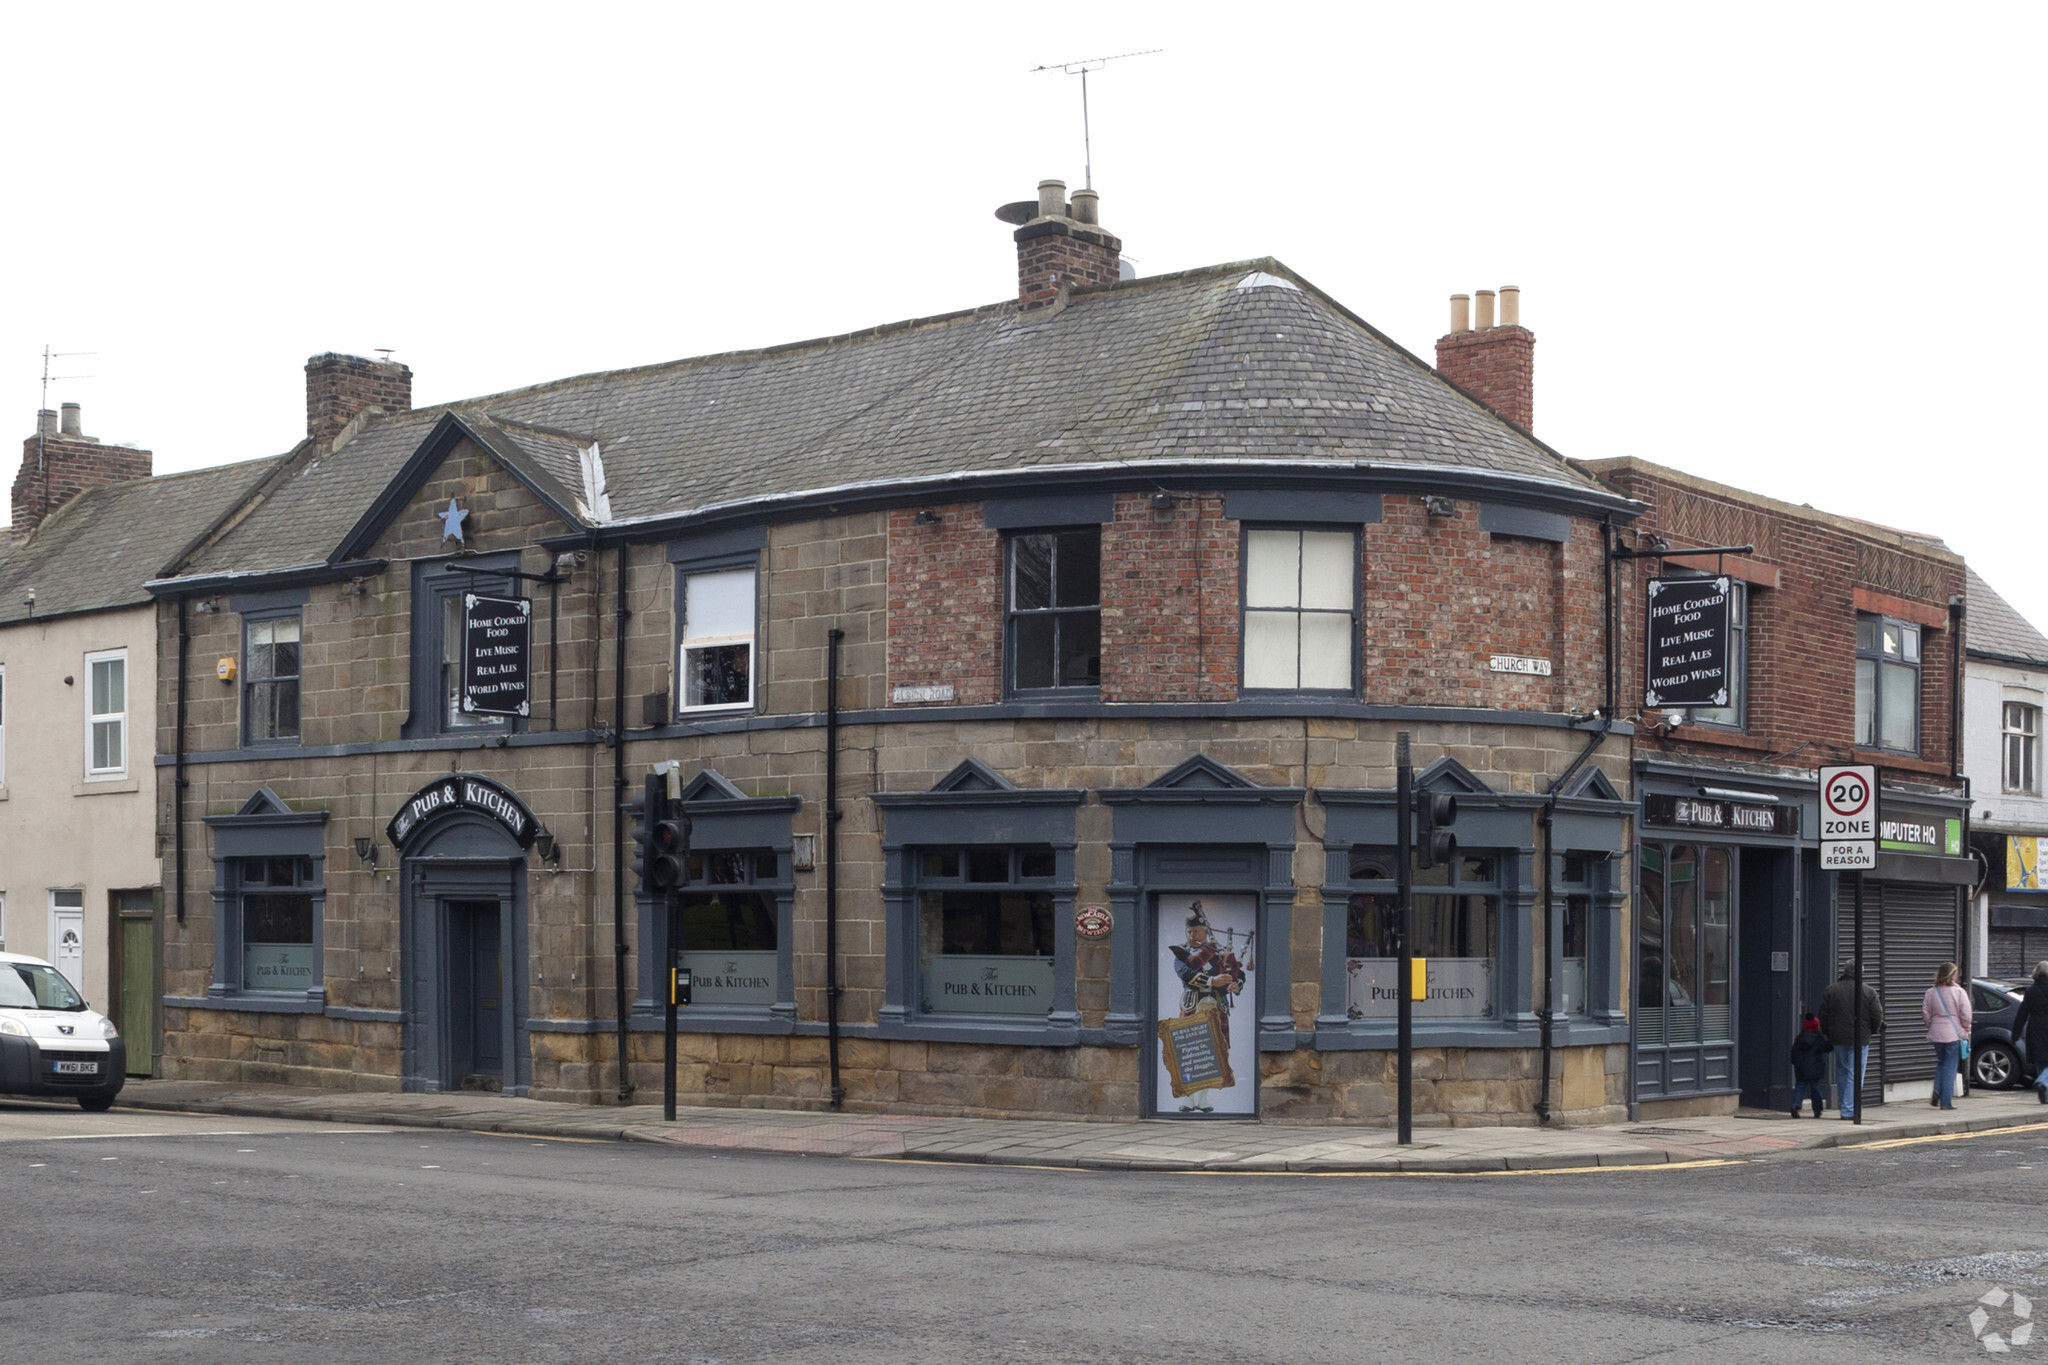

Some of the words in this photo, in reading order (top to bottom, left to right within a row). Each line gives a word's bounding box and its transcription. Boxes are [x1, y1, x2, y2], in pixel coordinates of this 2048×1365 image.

[1653, 604, 1681, 618] HOME
[1683, 595, 1724, 611] COOKED
[469, 618, 493, 629] HOME
[494, 616, 526, 627] COOKED
[1674, 612, 1701, 625] FOOD
[487, 628, 508, 638] FOOD
[1660, 635, 1681, 648] LIVE
[1683, 628, 1715, 643] MUSIC
[475, 647, 492, 658] LIVE
[494, 645, 519, 656] MUSIC
[1662, 655, 1687, 667] REAL
[1689, 649, 1712, 662] ALES
[477, 666, 497, 676] REAL
[499, 664, 517, 673] ALES
[1490, 657, 1529, 671] CHURCH
[1532, 660, 1550, 673] WAY
[1652, 674, 1688, 688] WORLD
[1691, 667, 1721, 681] WINES
[469, 685, 498, 695] WORLD
[500, 682, 525, 691] WINES
[930, 687, 954, 700] ROAD
[1833, 785, 1864, 803] 20
[412, 791, 439, 819] PUB
[443, 785, 457, 804] &
[466, 783, 525, 832] KITCHEN
[1691, 802, 1712, 823] PUB
[1714, 805, 1722, 823] &
[1733, 806, 1775, 827] KITCHEN
[1825, 821, 1870, 834] ZONE
[1880, 821, 1921, 843] MPUTER
[1923, 826, 1936, 845] HQ
[1833, 846, 1853, 855] FOR
[1856, 846, 1864, 854] A
[1826, 856, 1870, 865] REASON
[256, 965, 272, 976] PUB
[272, 966, 279, 976] &
[280, 965, 312, 976] KITCHEN
[981, 967, 998, 980] The
[692, 976, 712, 987] PUB
[714, 976, 723, 987] &
[726, 976, 770, 988] KITCHEN
[944, 982, 968, 995] PUB
[971, 983, 981, 995] &
[985, 983, 1037, 996] KITCHEN
[1371, 986, 1399, 999] PUB
[80, 1063, 96, 1072] BKE
